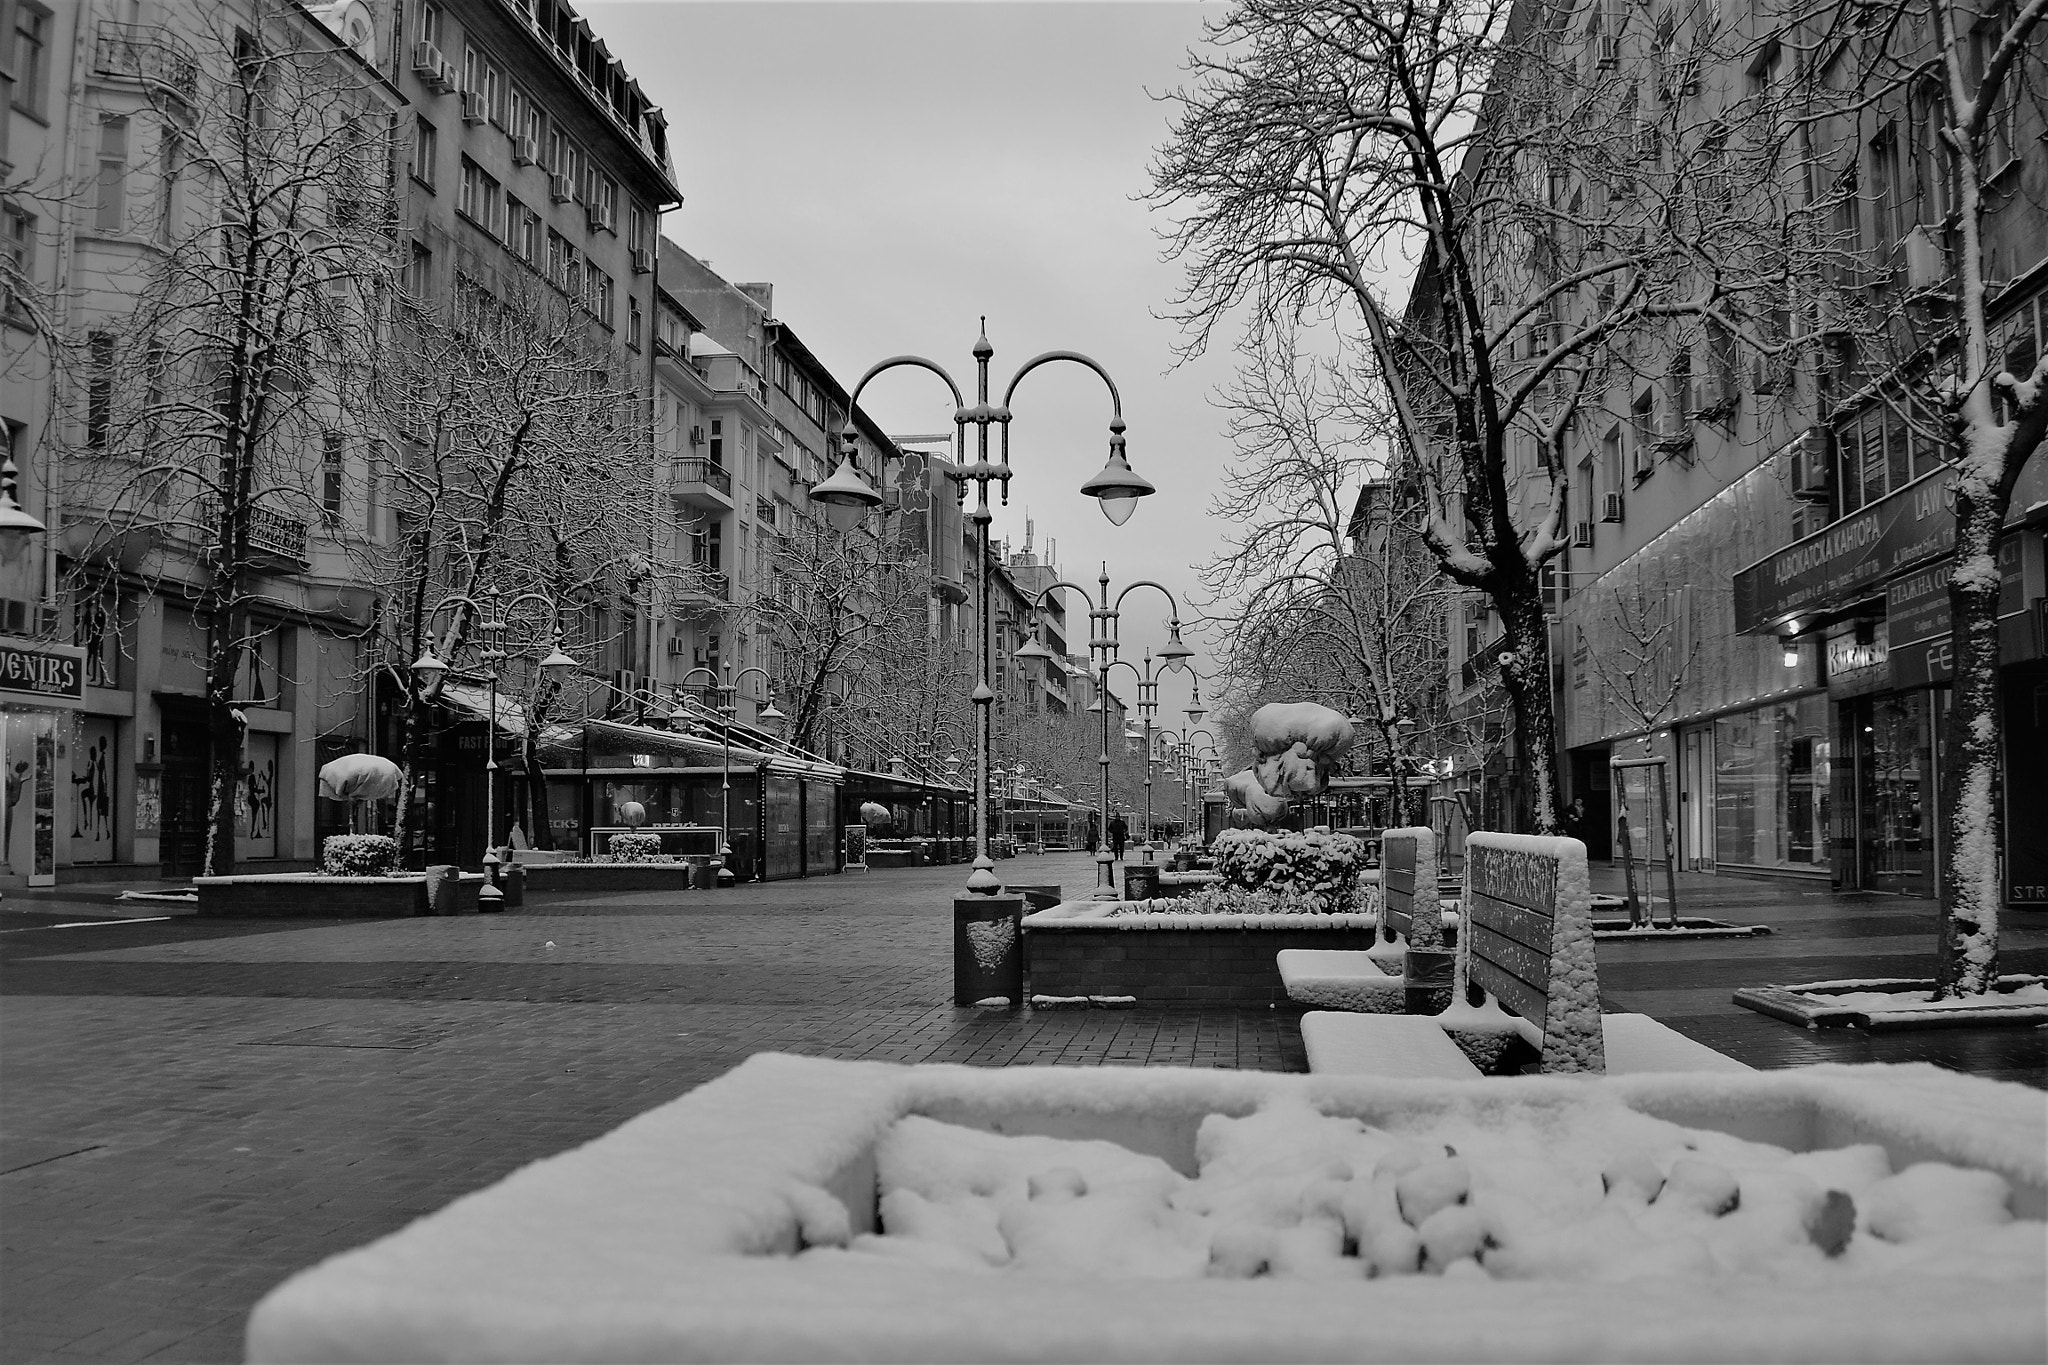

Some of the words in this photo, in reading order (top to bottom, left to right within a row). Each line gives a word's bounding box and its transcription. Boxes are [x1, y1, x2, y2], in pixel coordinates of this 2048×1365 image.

[1915, 483, 1942, 521] LAW
[1775, 538, 1833, 586] АДВОКАТСКА
[1834, 514, 1881, 558] КАНТОРА
[1891, 574, 1933, 606] ЕТАЖНА
[162, 644, 179, 662] ming
[458, 736, 482, 750] FAST
[484, 736, 508, 750] FOD
